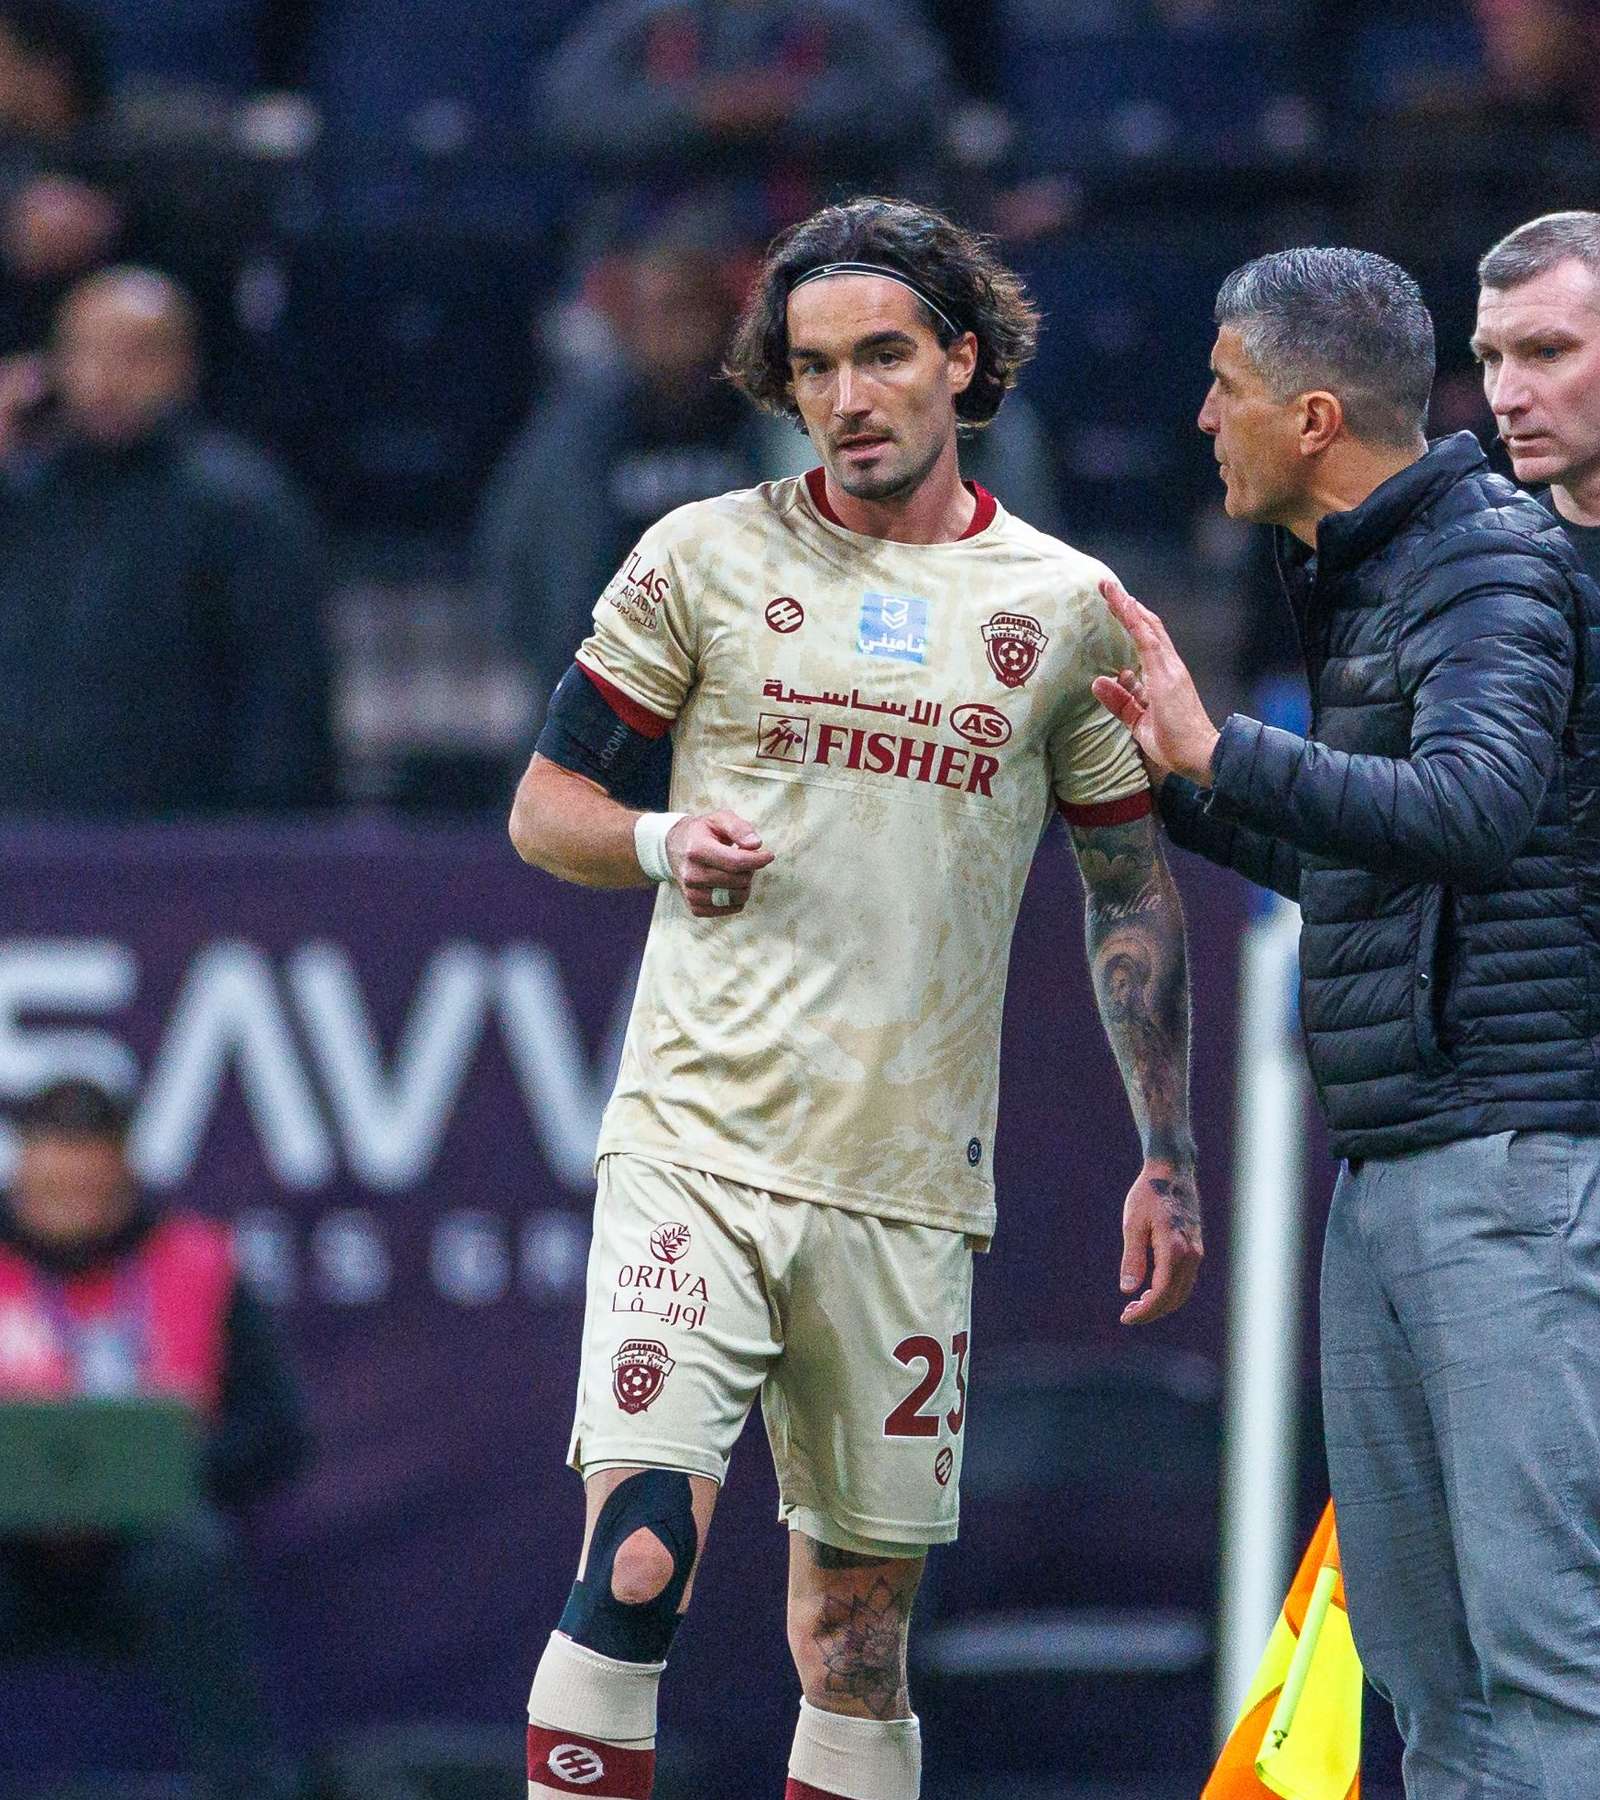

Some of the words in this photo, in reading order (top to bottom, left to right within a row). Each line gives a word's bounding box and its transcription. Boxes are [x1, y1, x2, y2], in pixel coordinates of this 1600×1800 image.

[621, 551, 670, 604] TLAS
[959, 713, 1005, 738] AS
[813, 723, 1001, 799] FISHER
[618, 1264, 710, 1303] ORIVA
[883, 1330, 970, 1438] 23
